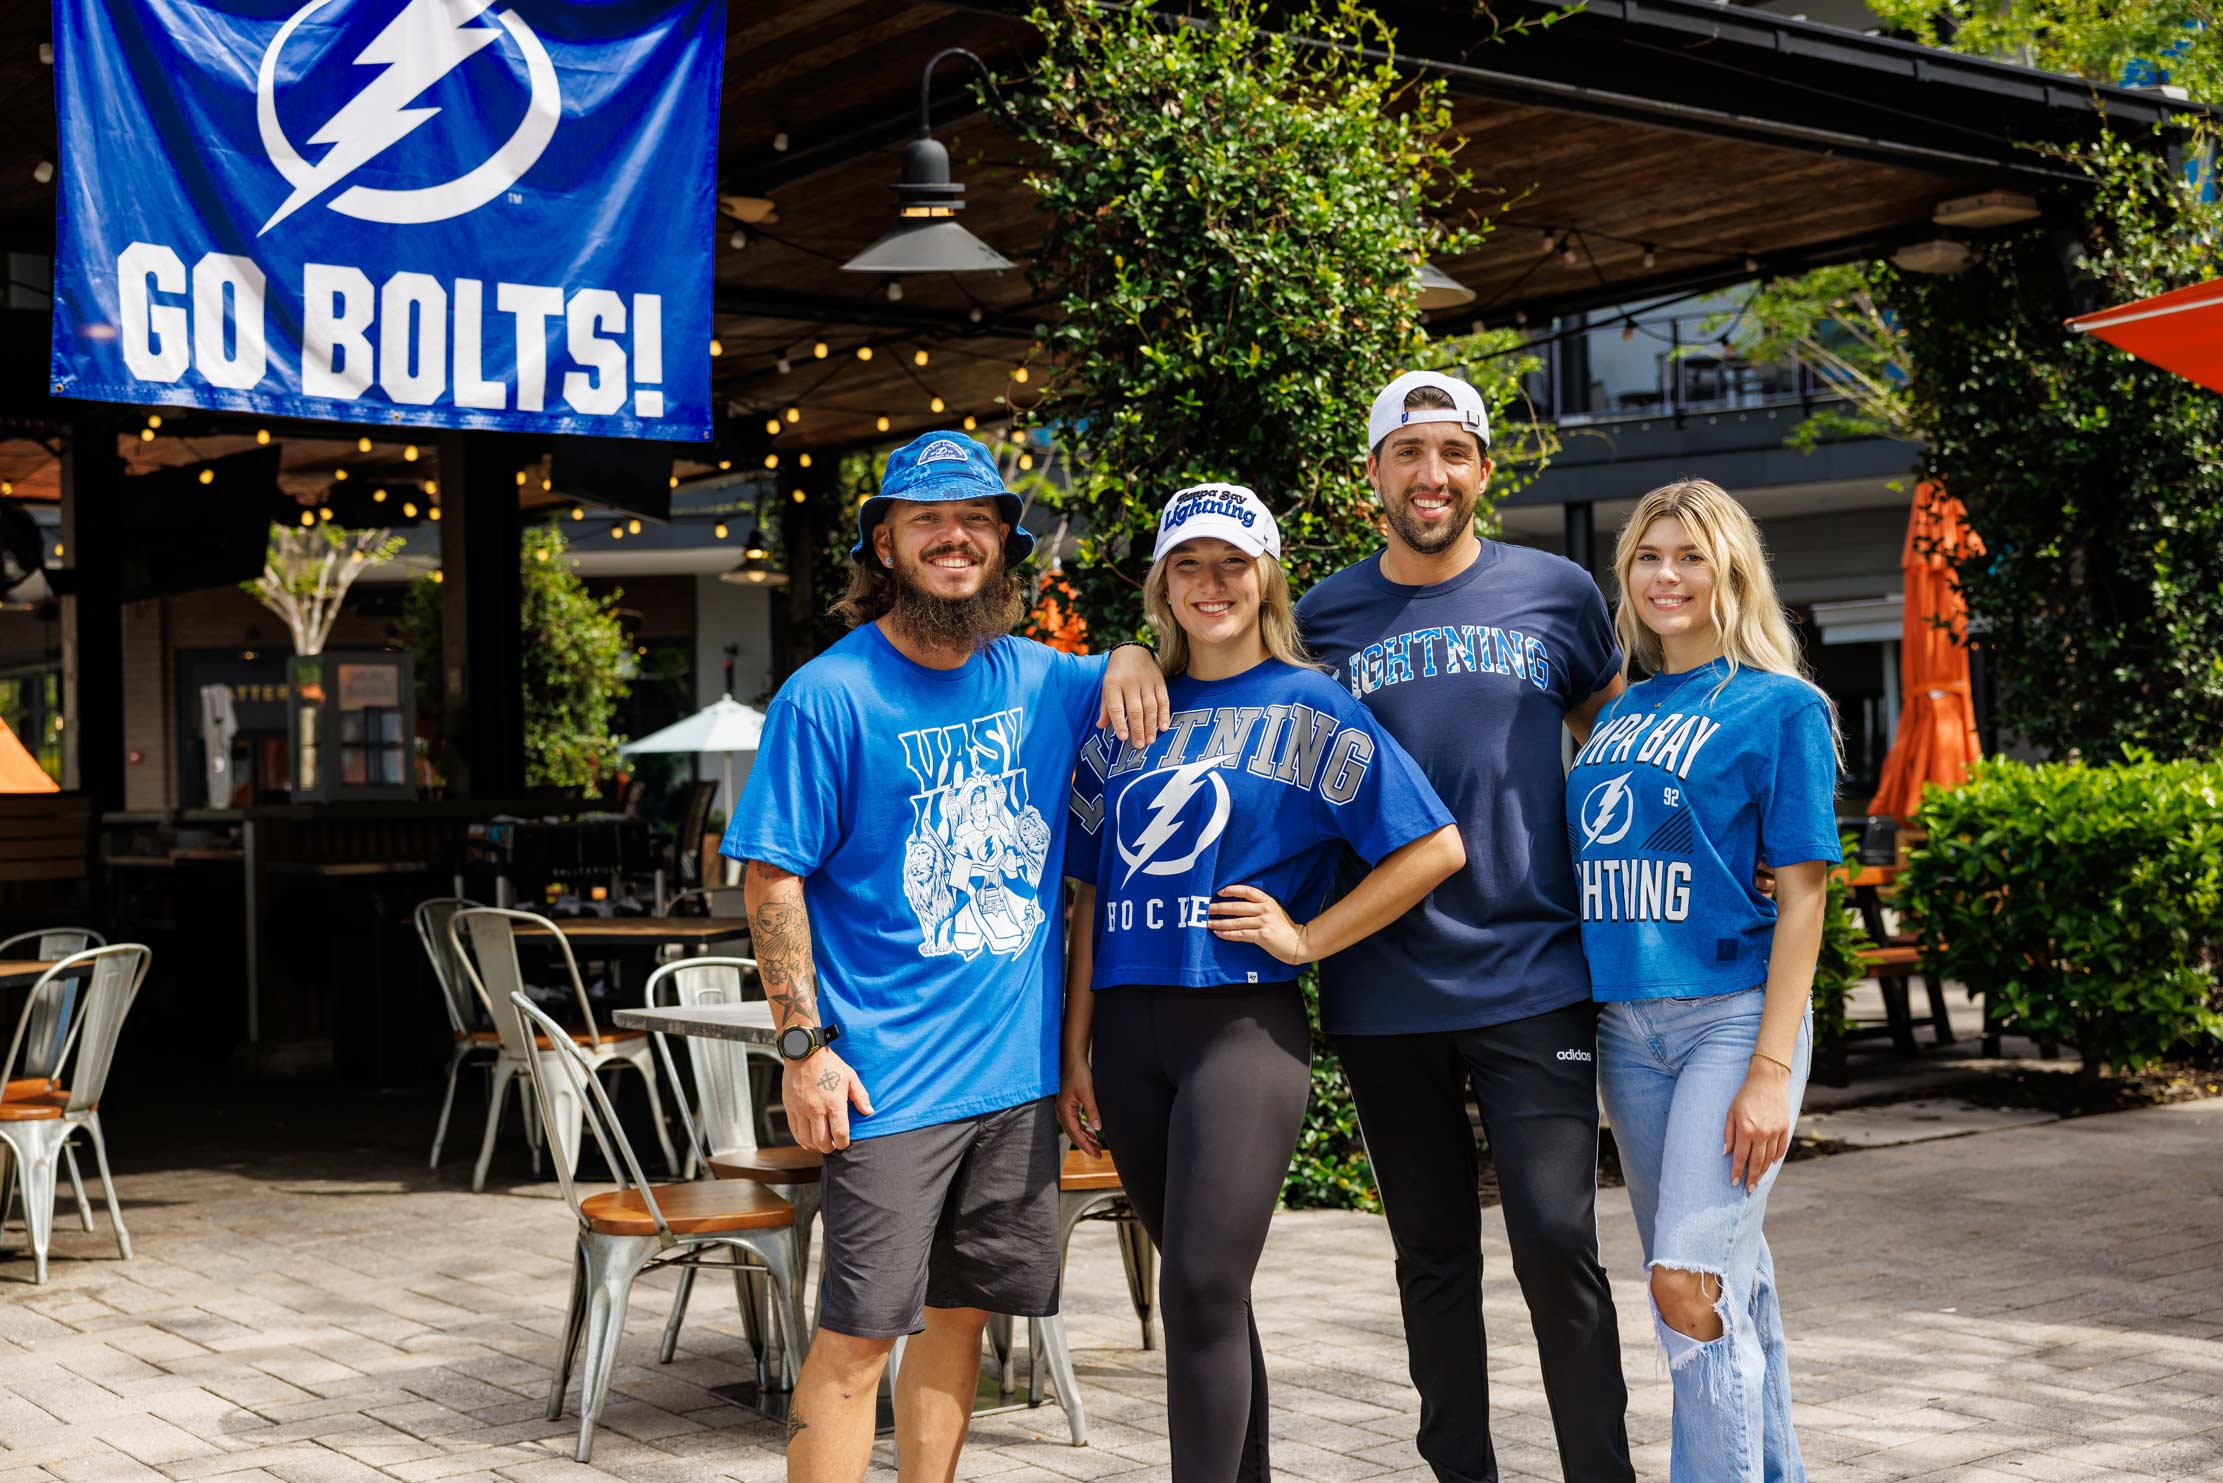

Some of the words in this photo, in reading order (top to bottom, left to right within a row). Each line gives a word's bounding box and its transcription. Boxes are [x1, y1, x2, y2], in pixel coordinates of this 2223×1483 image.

[118, 241, 266, 390] GO
[303, 263, 664, 418] BOLTS!
[1176, 489, 1218, 504] Tampa
[1219, 491, 1247, 504] Bay
[1163, 498, 1257, 532] Lightning
[1331, 625, 1550, 700] IGHTNING
[1571, 713, 1656, 771] MPA
[1634, 713, 1721, 780] BAY
[1663, 787, 1680, 807] 92
[1556, 1049, 1592, 1061] adidas
